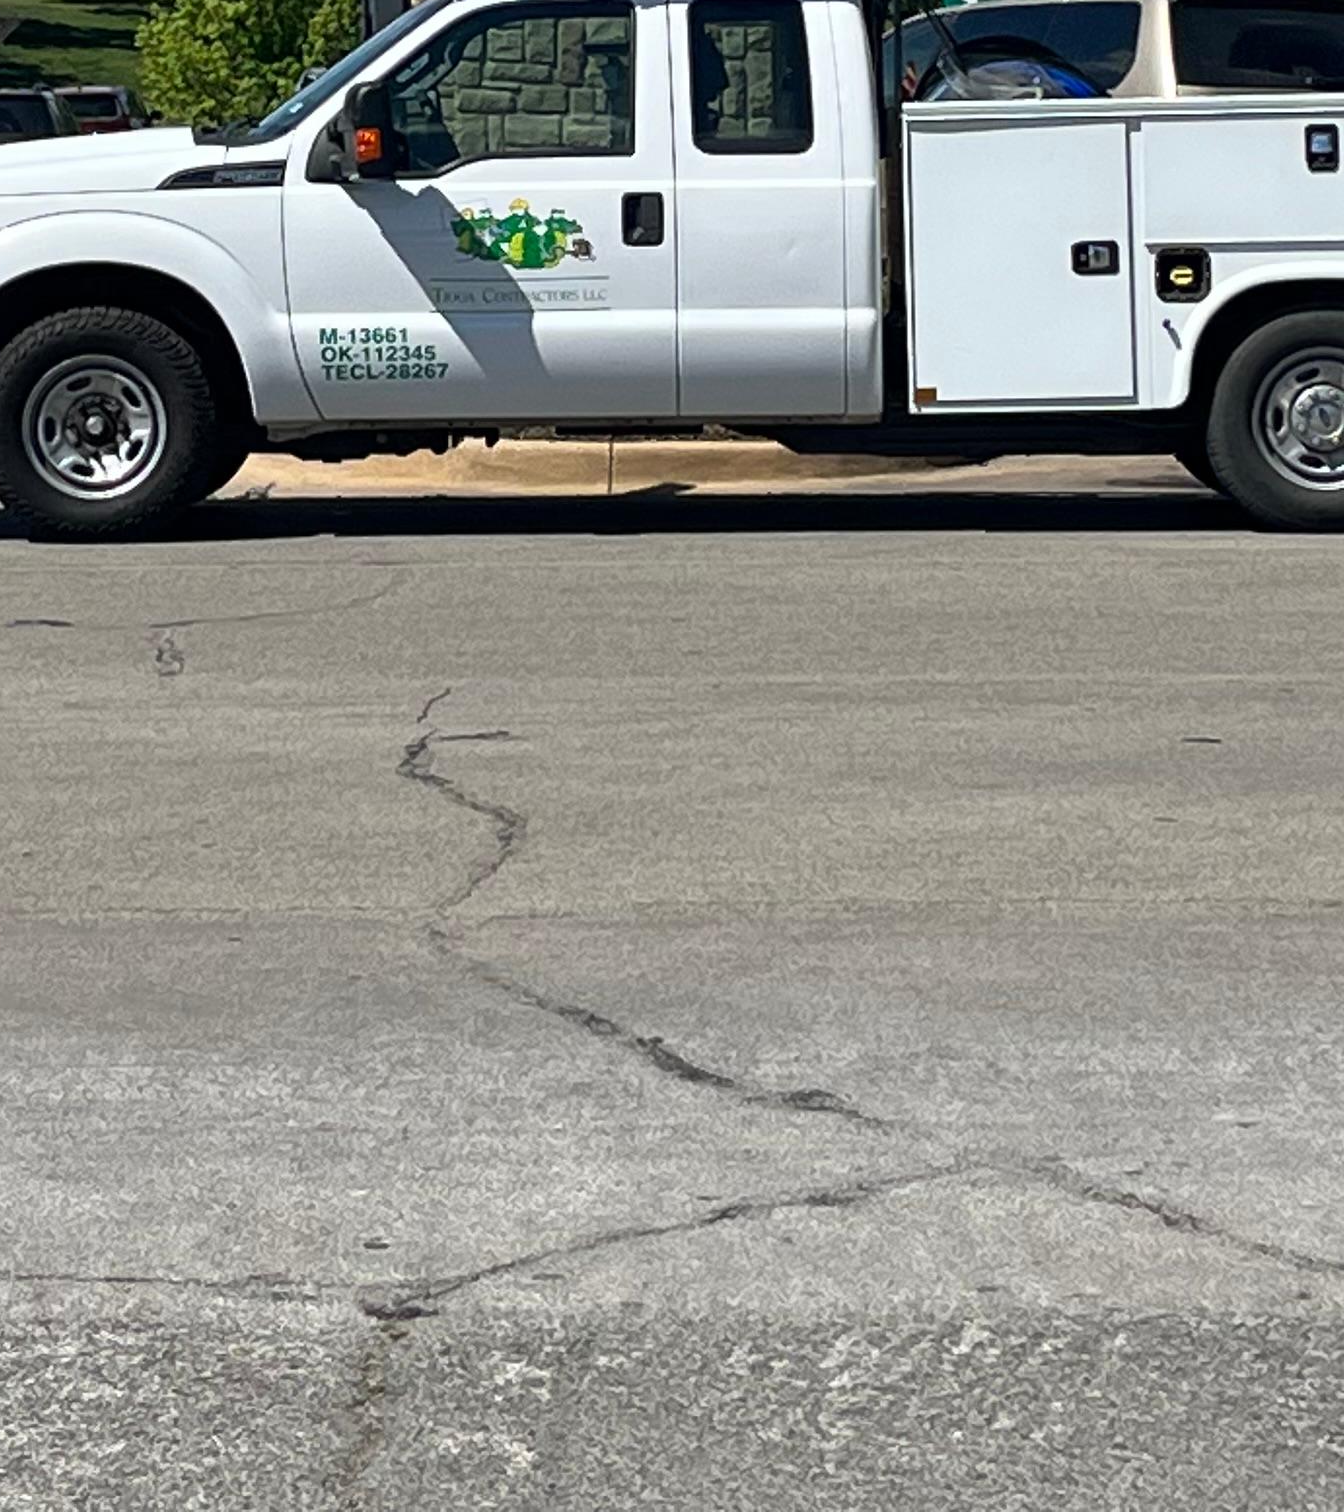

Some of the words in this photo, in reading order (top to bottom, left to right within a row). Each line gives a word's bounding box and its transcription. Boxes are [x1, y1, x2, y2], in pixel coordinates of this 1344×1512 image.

[583, 288, 608, 301] LLC
[319, 327, 408, 344] M-13661
[321, 345, 436, 362] OK-112345
[322, 363, 449, 380] TECL-28267
